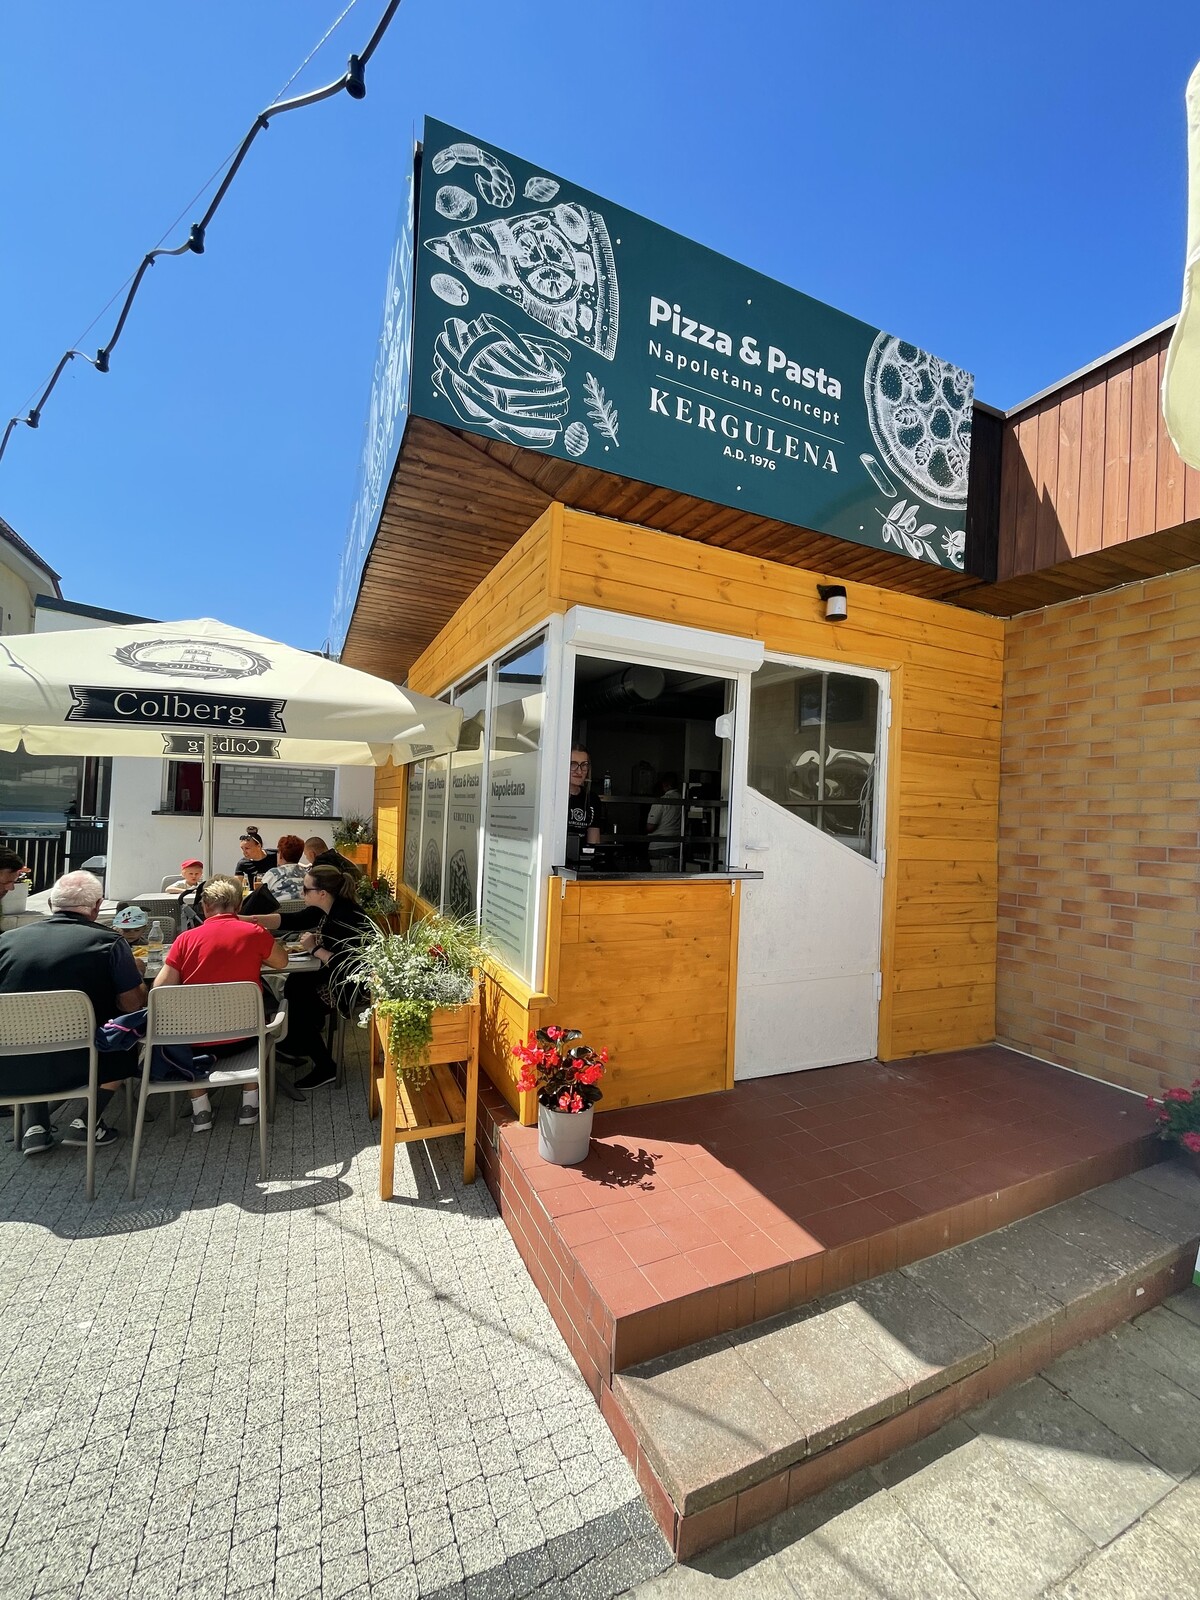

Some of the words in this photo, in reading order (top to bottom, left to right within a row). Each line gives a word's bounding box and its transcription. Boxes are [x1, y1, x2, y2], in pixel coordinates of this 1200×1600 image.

[649, 295, 733, 357] Pizza
[739, 336, 762, 367] &
[767, 345, 842, 400] Pasta
[648, 339, 763, 397] Napoletana
[771, 388, 840, 426] Concept
[649, 387, 839, 474] KERGULENA
[723, 445, 747, 462] A.D.
[749, 454, 776, 471] 1976
[155, 662, 227, 673] Colberg
[113, 692, 246, 725] Colberg
[491, 779, 525, 800] Napoletana
